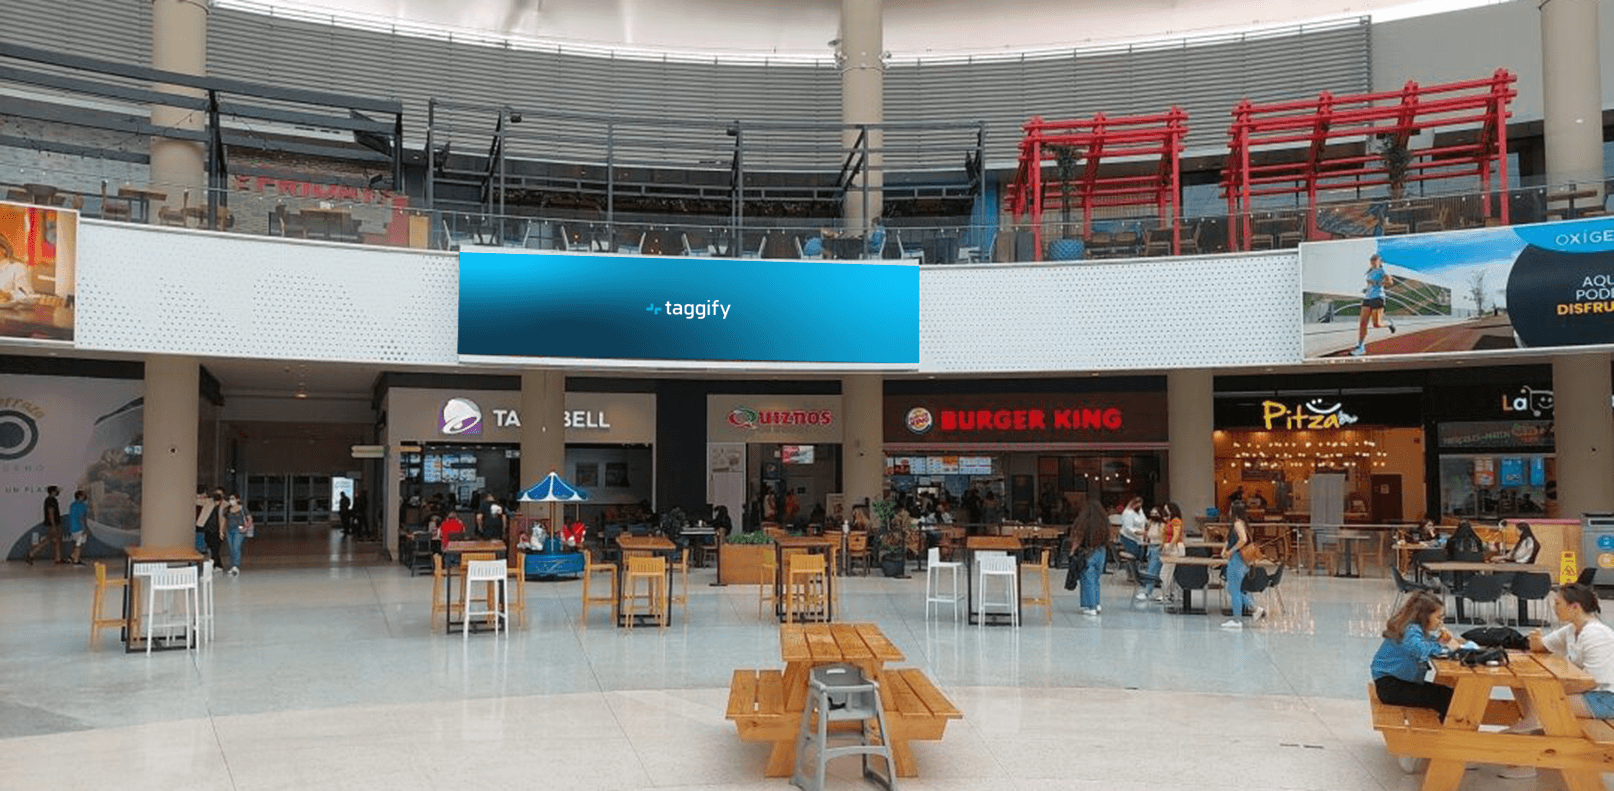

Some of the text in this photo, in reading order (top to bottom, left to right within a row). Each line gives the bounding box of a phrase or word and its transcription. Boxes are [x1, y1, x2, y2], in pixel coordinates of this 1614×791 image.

[665, 300, 731, 319] taggify
[941, 408, 1122, 430] BURGER KING
[1263, 400, 1340, 430] Pitza
